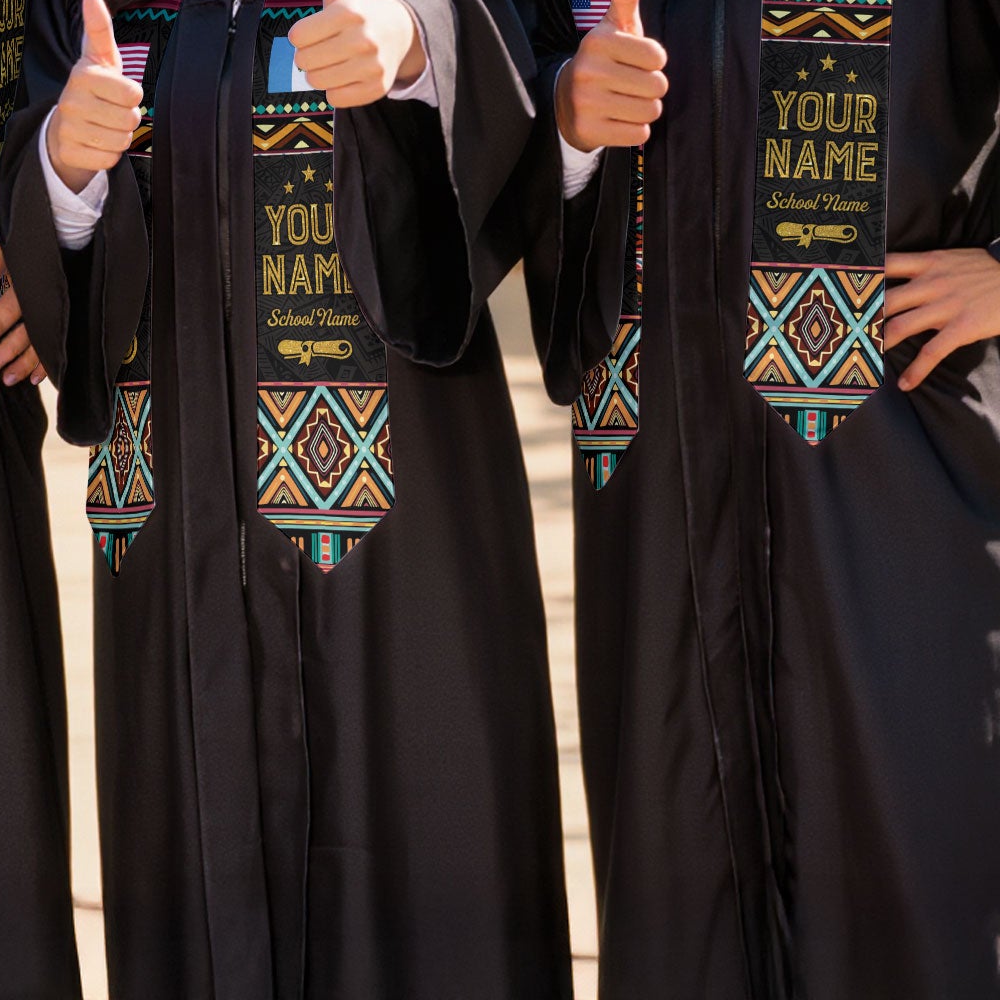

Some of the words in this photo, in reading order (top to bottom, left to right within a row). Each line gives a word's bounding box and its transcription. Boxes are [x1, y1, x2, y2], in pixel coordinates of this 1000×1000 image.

[772, 90, 878, 134] YOUR
[764, 138, 879, 182] NAME
[766, 191, 821, 210] School
[822, 193, 870, 212] Name
[264, 202, 334, 246] YOU
[266, 308, 315, 327] School
[316, 307, 361, 327] Name
